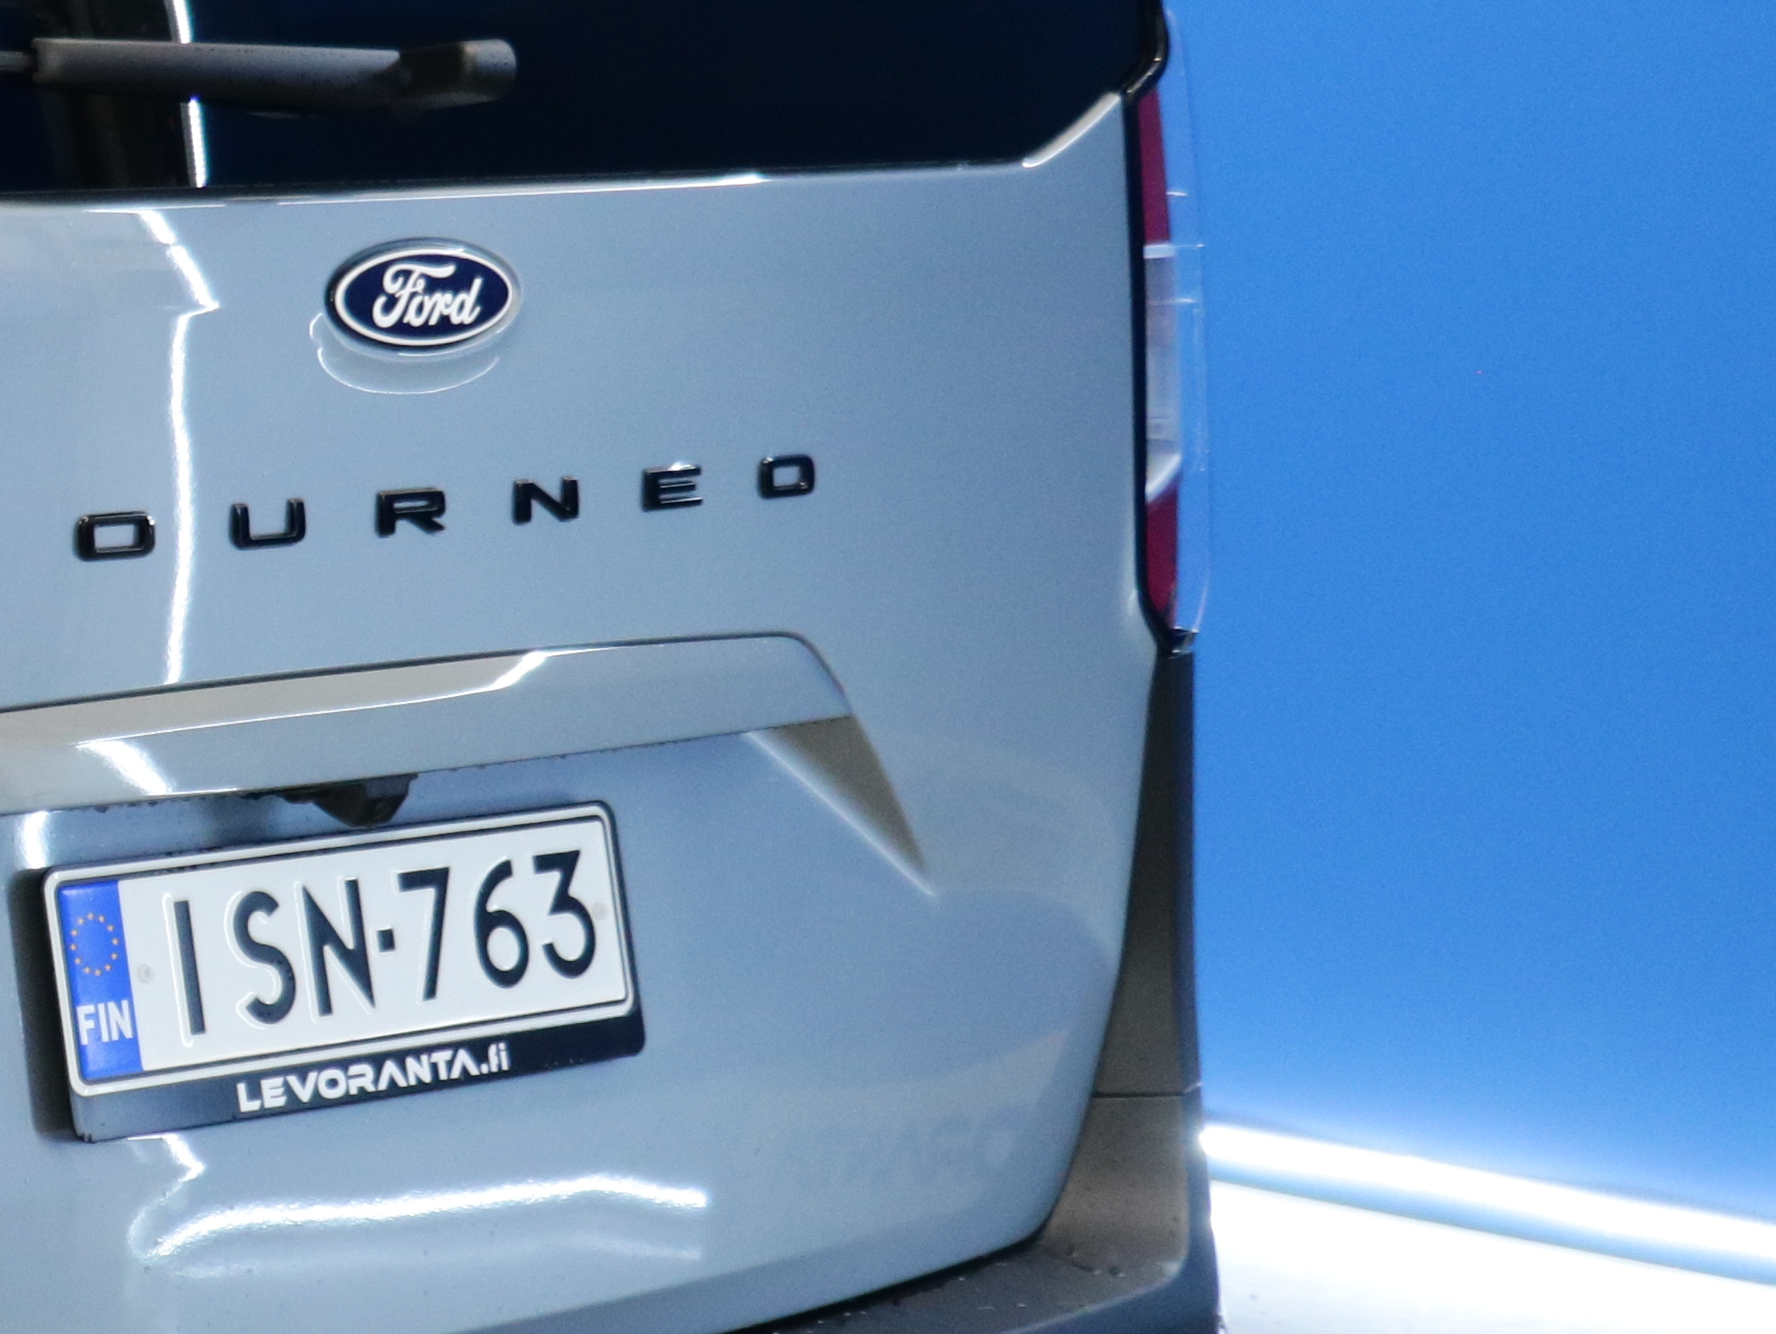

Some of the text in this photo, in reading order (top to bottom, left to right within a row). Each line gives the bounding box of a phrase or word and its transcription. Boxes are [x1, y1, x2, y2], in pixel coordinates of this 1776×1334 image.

[371, 263, 483, 329] Ford
[170, 849, 596, 1036] ISN-763
[76, 999, 134, 1046] FIN
[236, 1042, 510, 1113] LEVORANTA.fi
